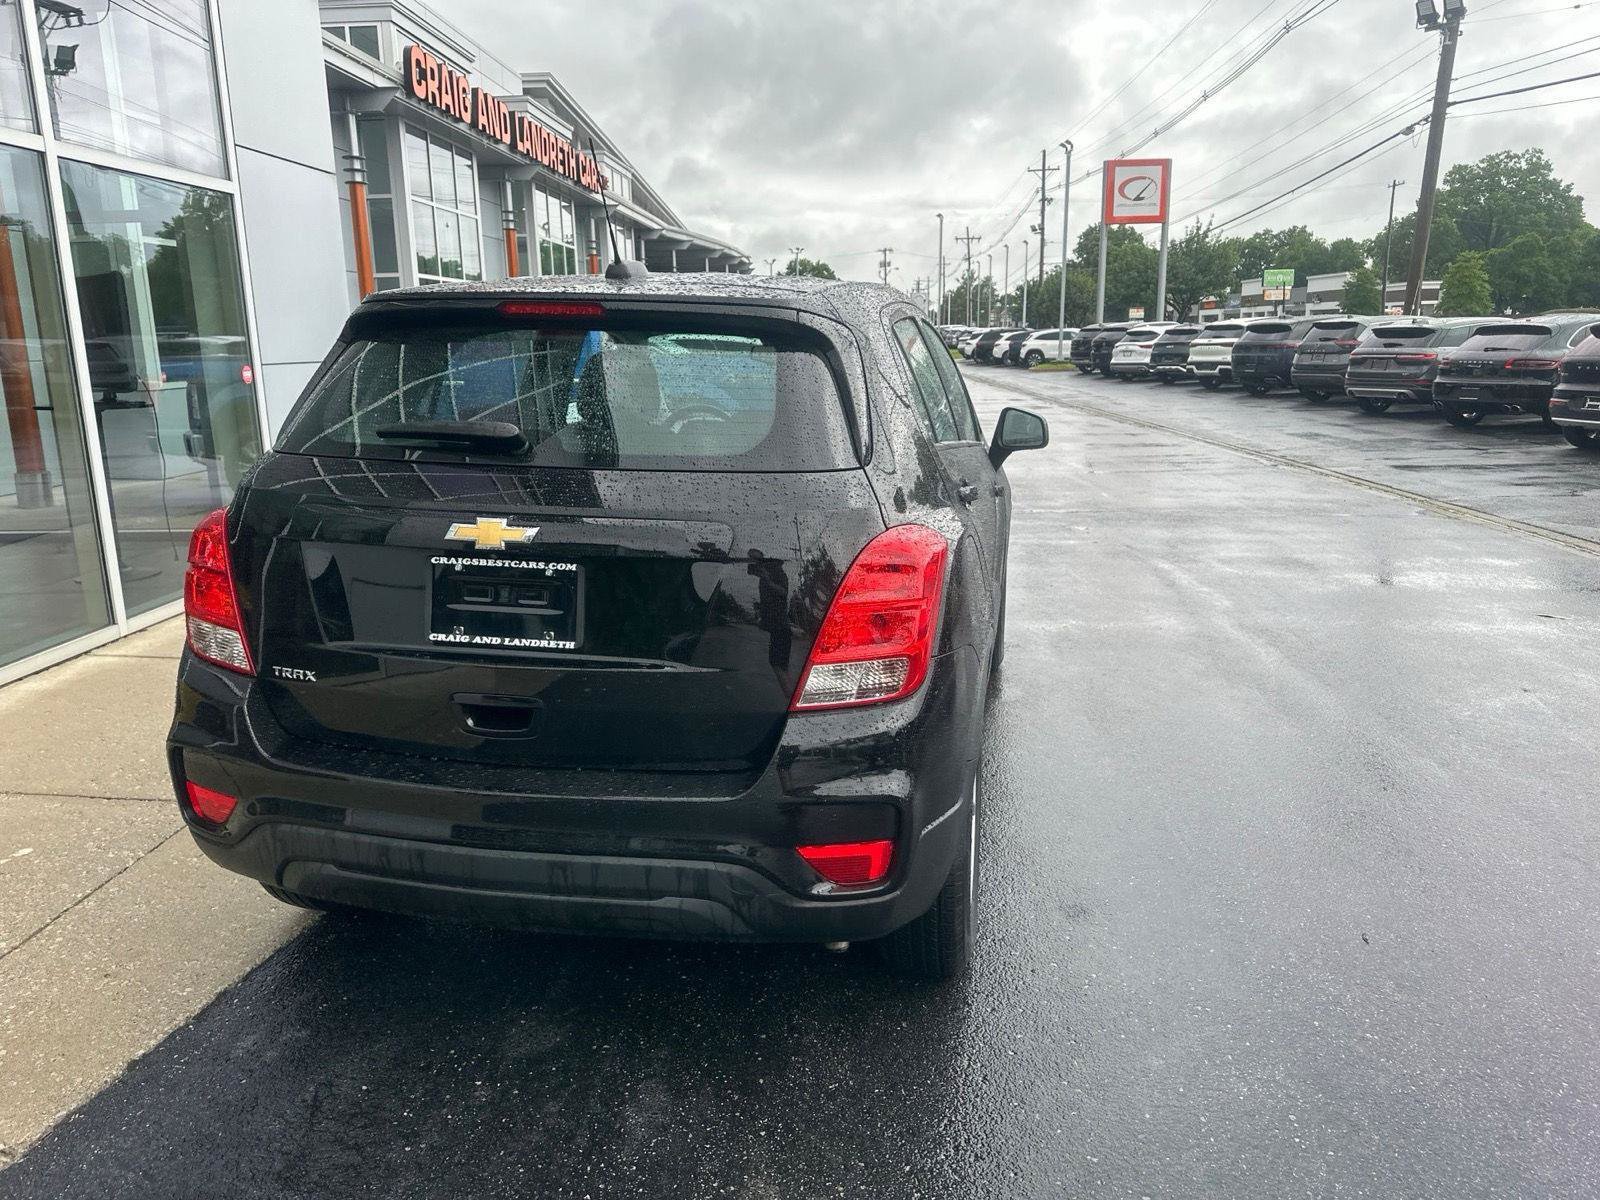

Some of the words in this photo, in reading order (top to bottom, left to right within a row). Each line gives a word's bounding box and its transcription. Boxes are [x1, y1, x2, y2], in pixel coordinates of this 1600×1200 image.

[406, 42, 472, 124] CRAIG
[474, 87, 511, 145] AND
[512, 110, 577, 181] LANDRETH
[430, 556, 577, 571] CRAIGSBESTCARS.COM
[428, 633, 470, 643] CRAIG
[472, 635, 501, 645] AND
[503, 637, 576, 649] LANDRETH
[272, 665, 317, 682] TRAX
